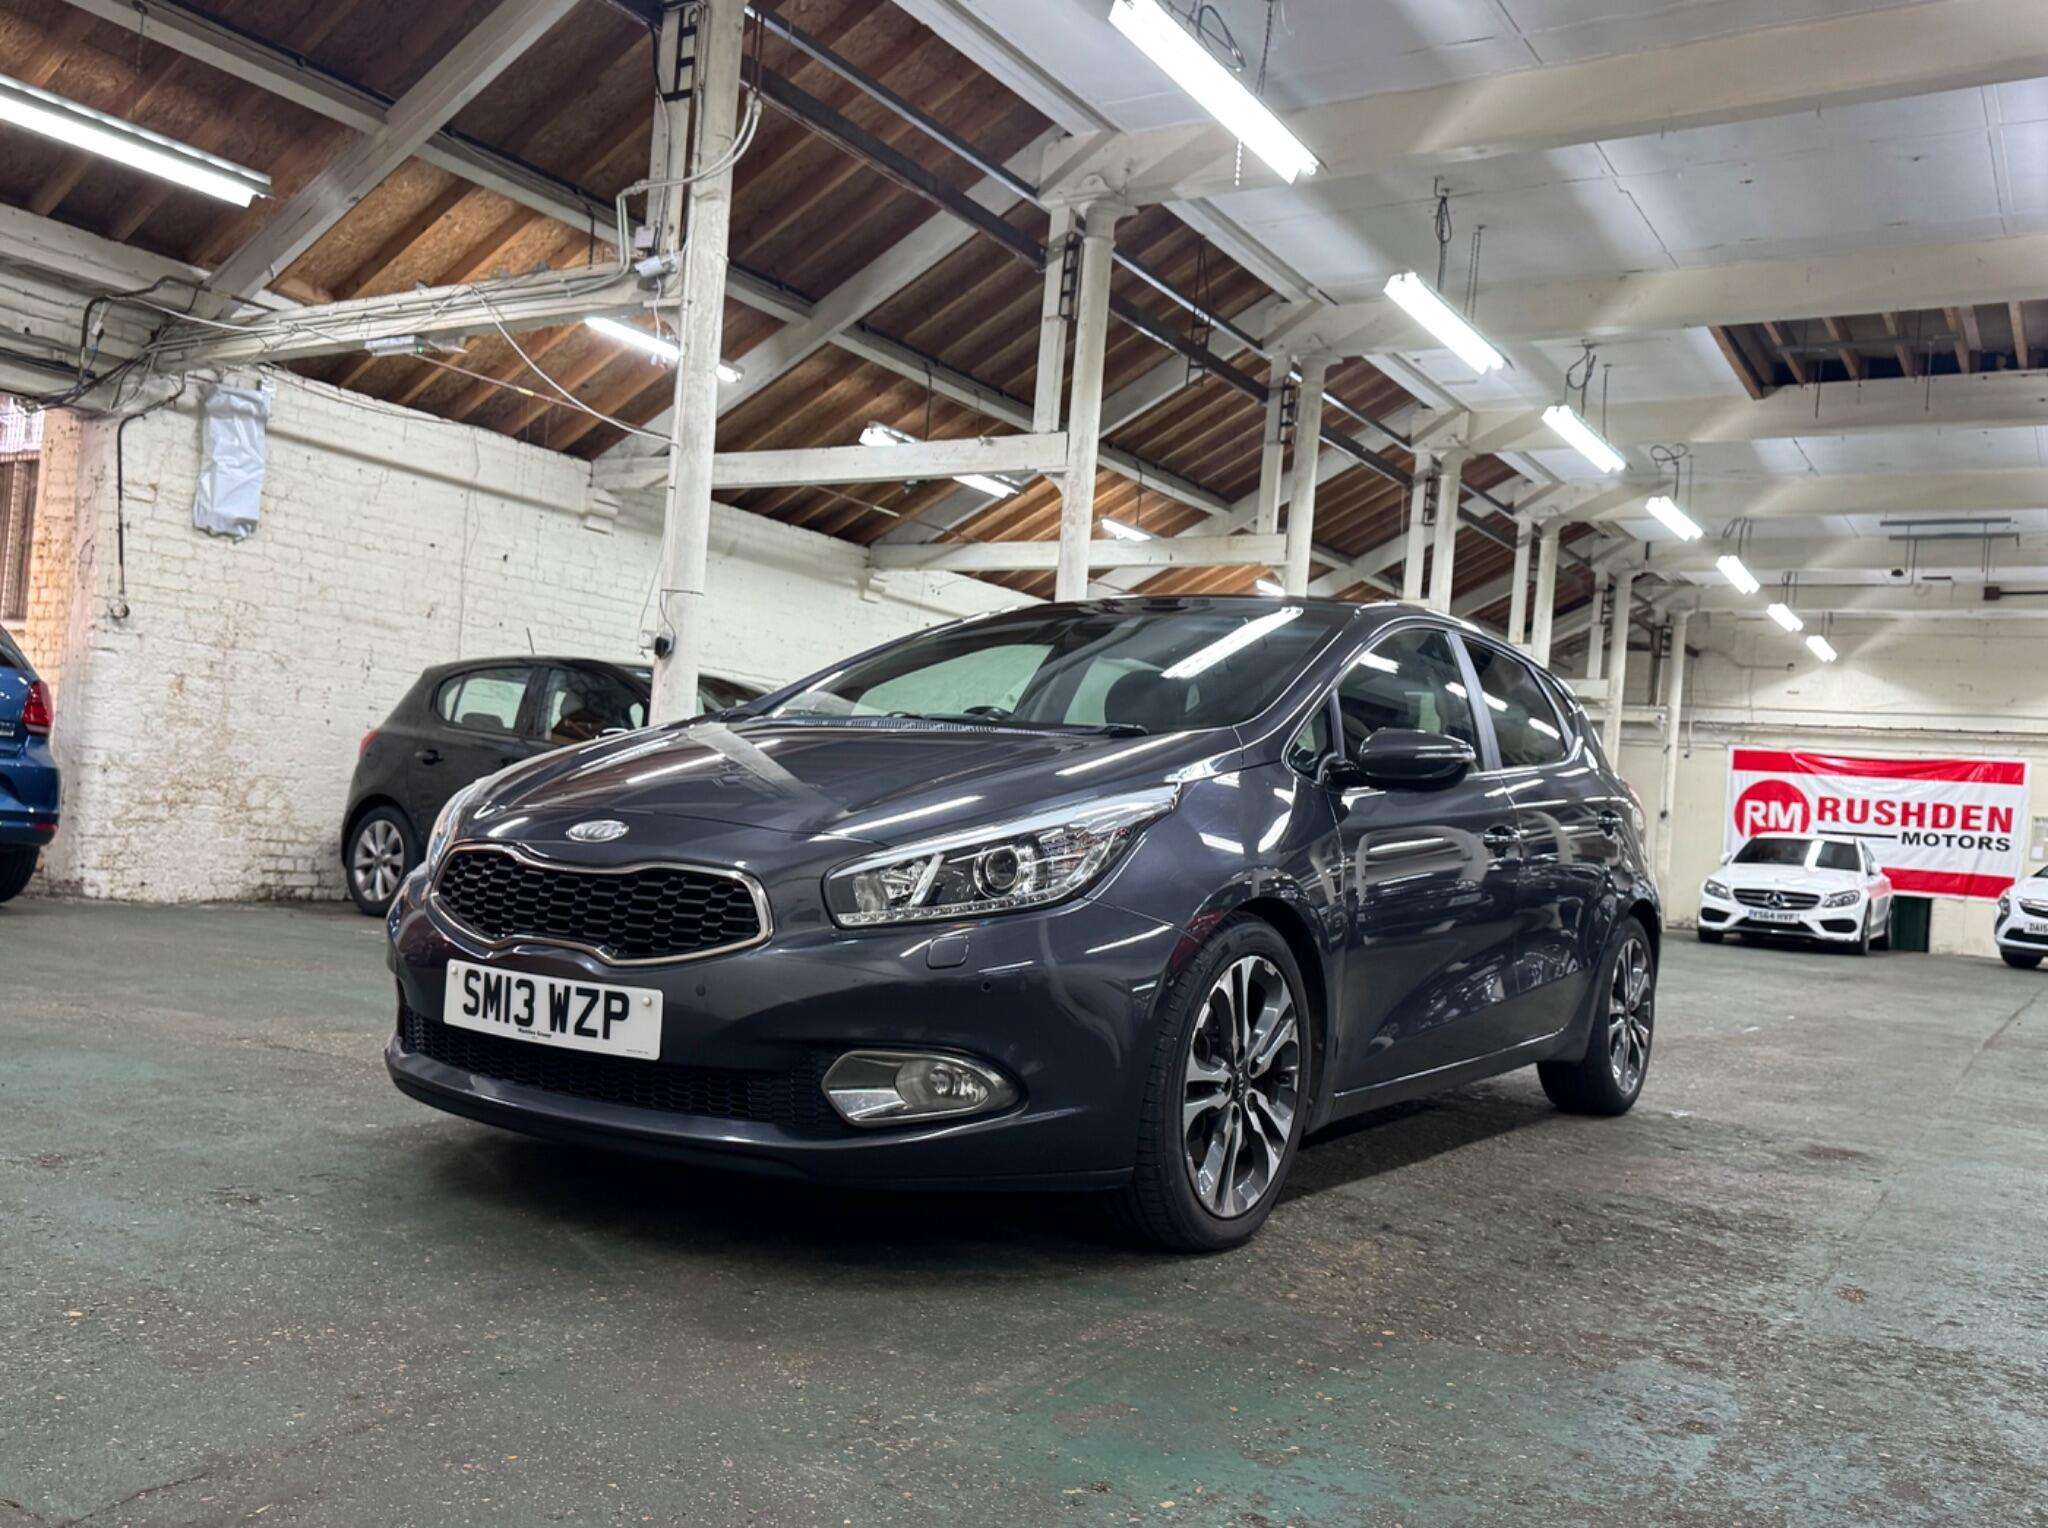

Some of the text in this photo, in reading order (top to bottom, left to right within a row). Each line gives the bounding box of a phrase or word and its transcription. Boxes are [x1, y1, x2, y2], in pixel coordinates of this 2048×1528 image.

[1743, 799, 1803, 836] RM
[1817, 796, 2014, 834] RUSHDEN
[1901, 831, 2011, 852] MOTORS
[463, 968, 630, 1040] SM13 WZP
